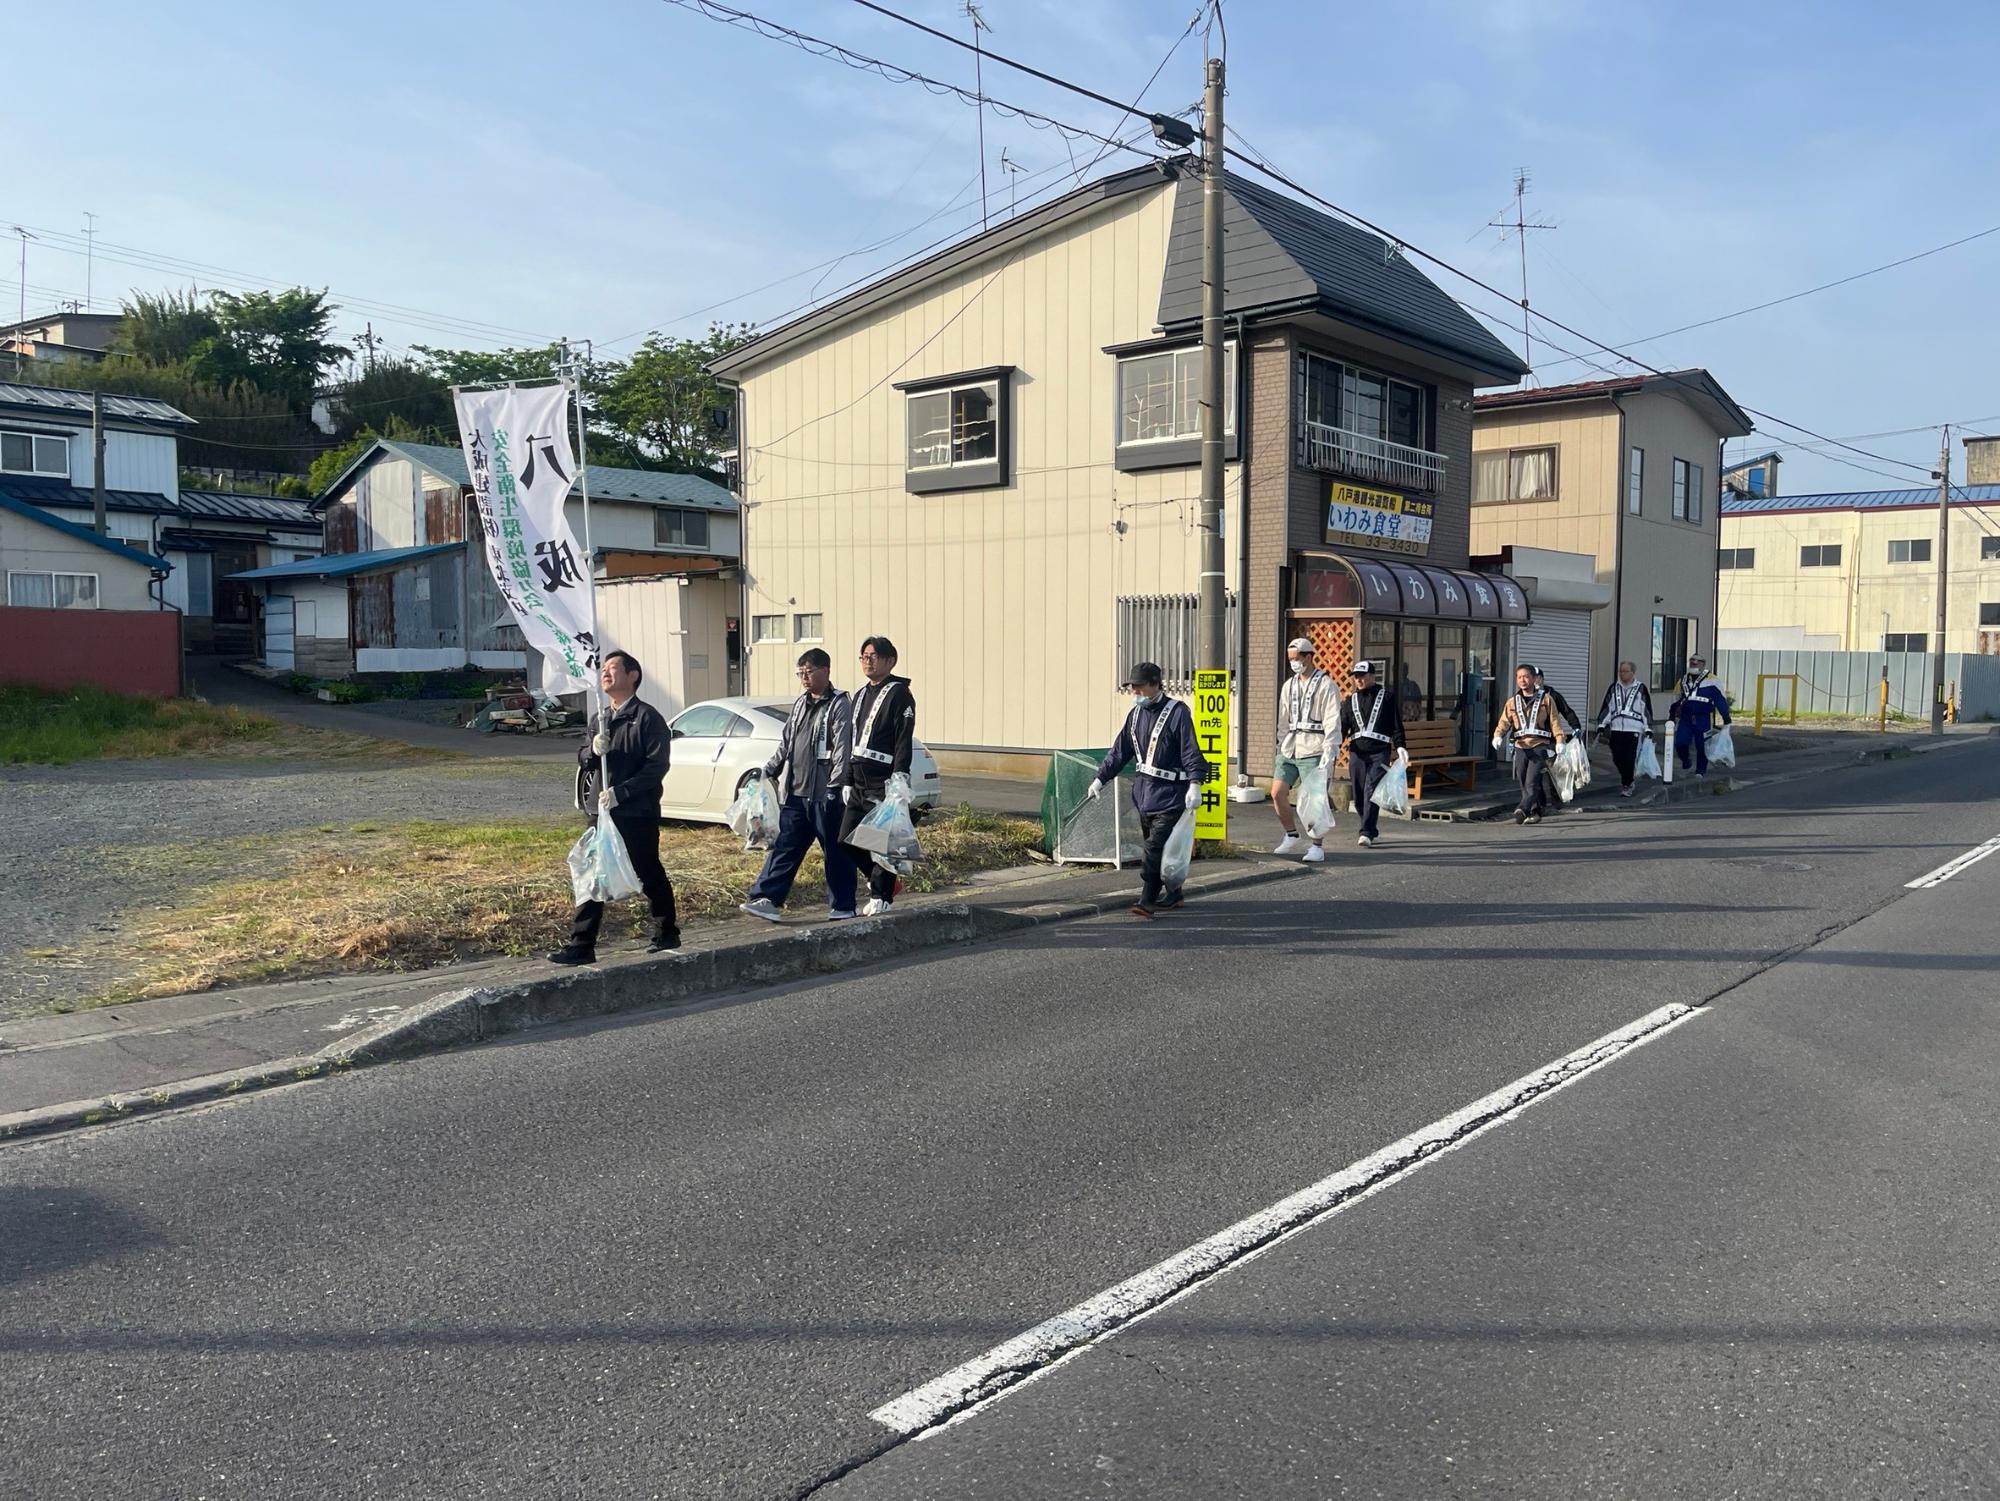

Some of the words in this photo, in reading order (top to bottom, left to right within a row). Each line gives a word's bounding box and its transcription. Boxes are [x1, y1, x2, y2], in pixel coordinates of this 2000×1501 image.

[1328, 503, 1402, 538] いわみ食堂
[1339, 531, 1356, 545] TEL
[1370, 573, 1519, 609] いわみ食堂
[1199, 694, 1226, 714] 100
[1200, 717, 1223, 728] m先
